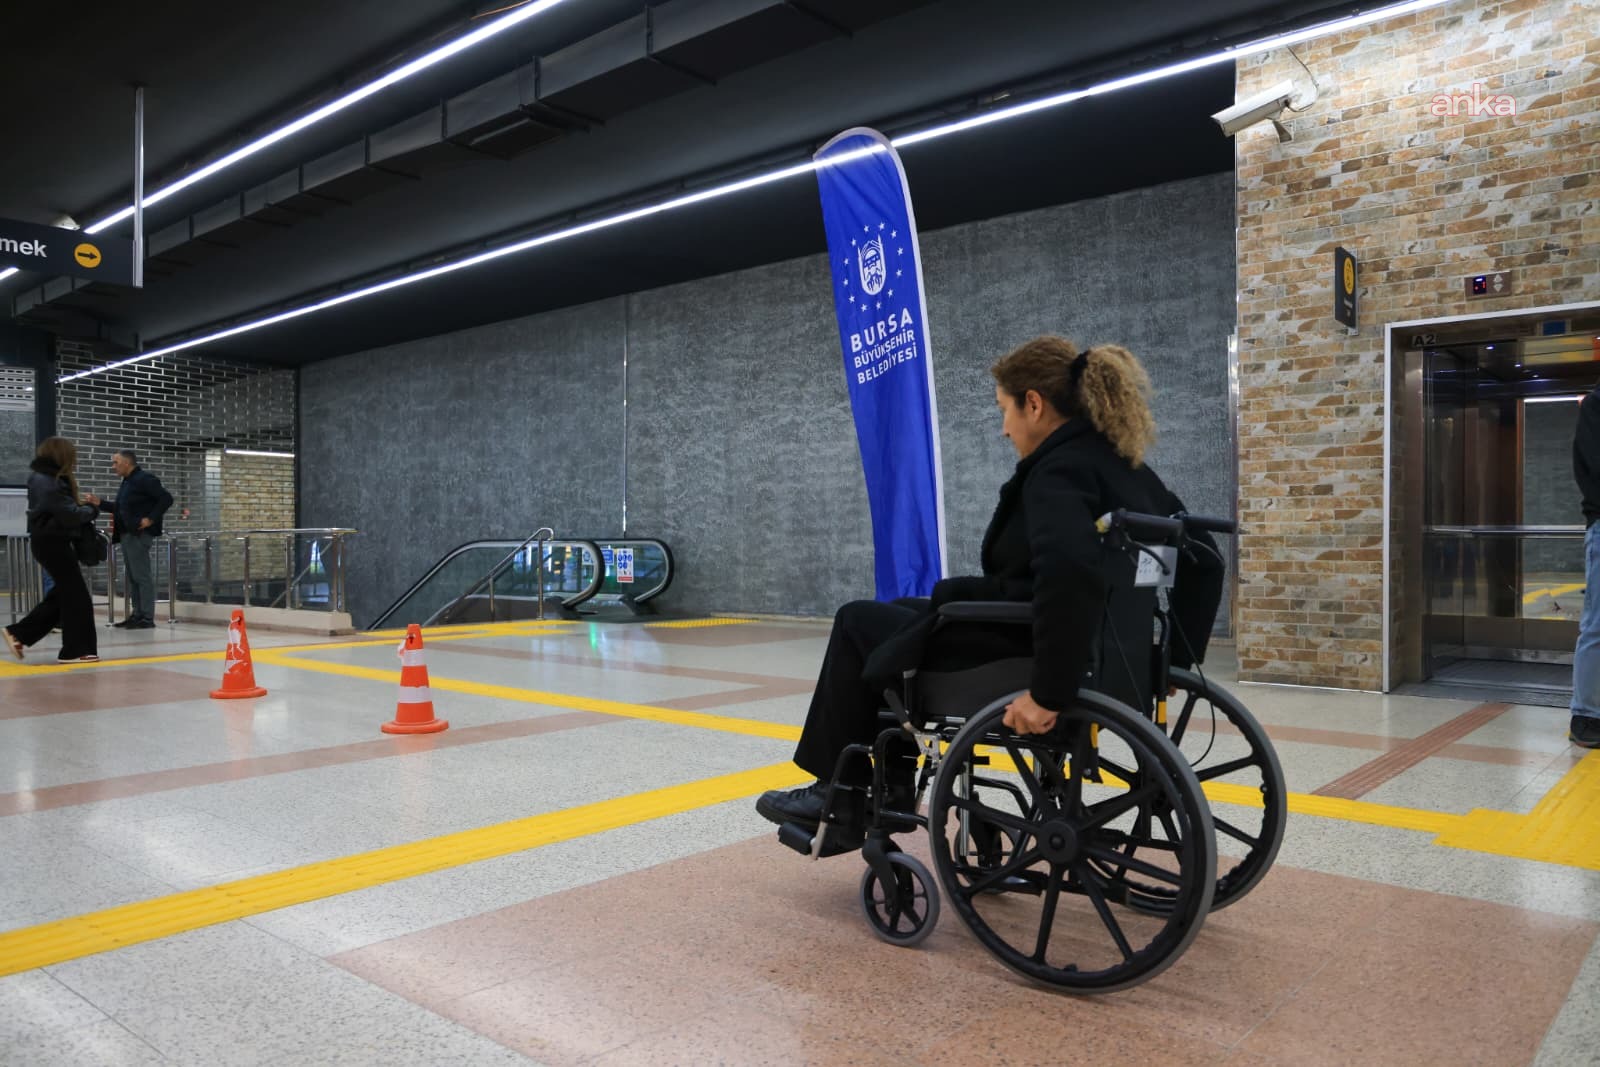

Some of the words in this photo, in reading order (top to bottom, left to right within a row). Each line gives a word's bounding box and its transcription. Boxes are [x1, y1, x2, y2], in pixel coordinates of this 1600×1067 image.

[850, 307, 913, 353] BURSA
[1415, 334, 1435, 347] A2
[857, 342, 917, 384] BELEDİYESİ
